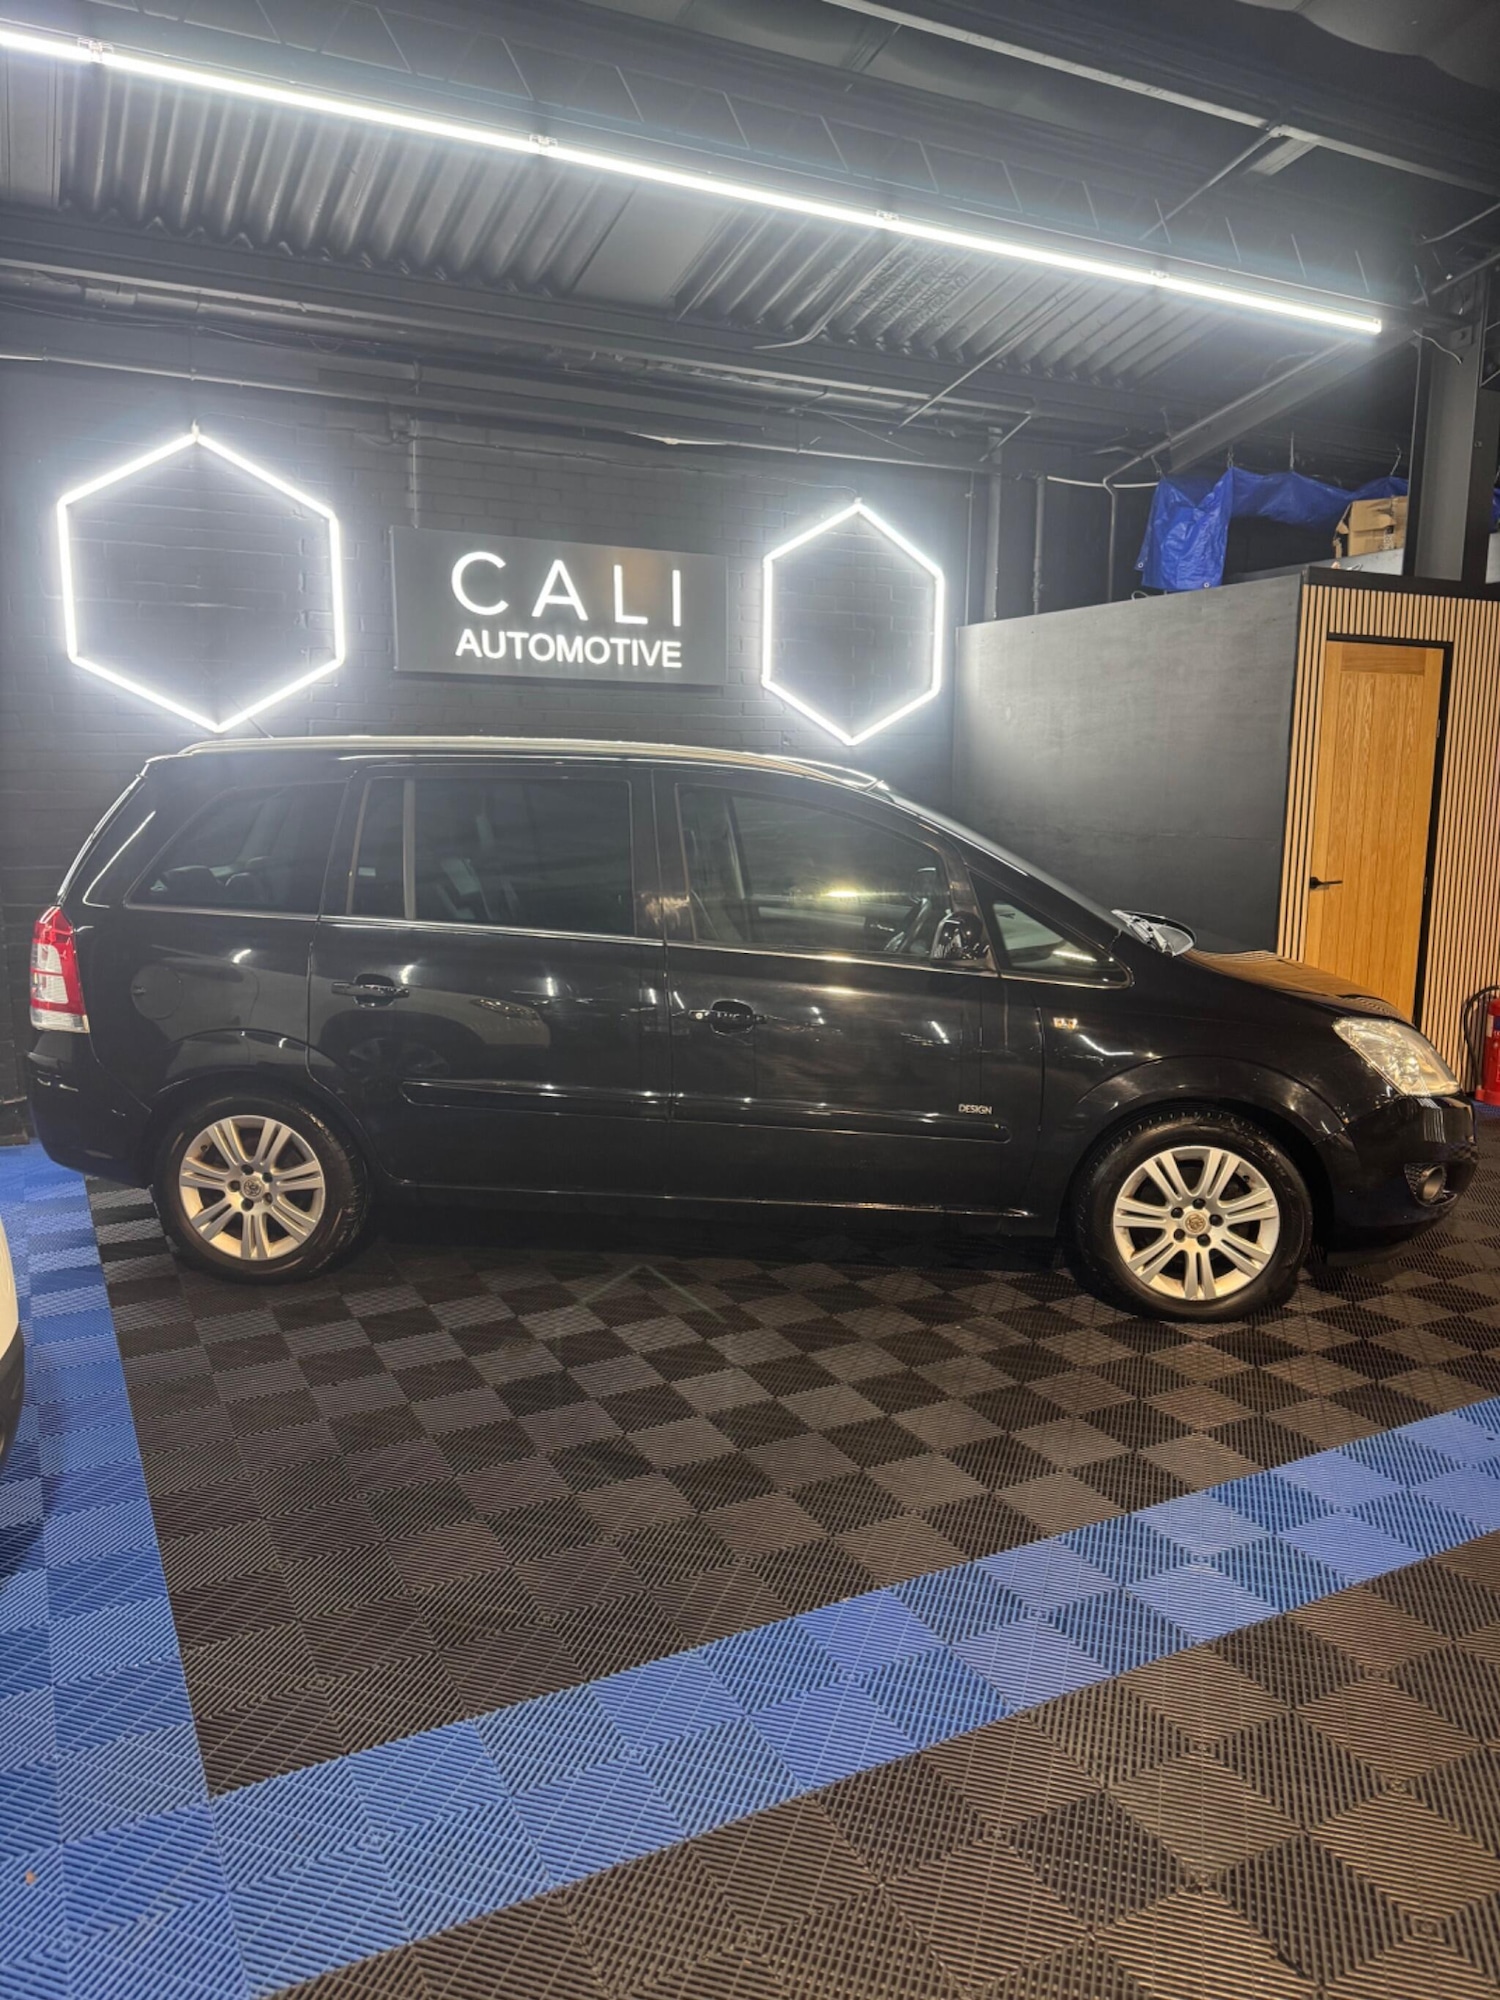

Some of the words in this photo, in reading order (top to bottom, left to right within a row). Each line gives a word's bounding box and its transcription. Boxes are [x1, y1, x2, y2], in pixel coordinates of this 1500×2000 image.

[451, 551, 682, 627] CALI
[455, 628, 682, 668] AUTOMOTIVE
[958, 1103, 993, 1115] DESIGN
